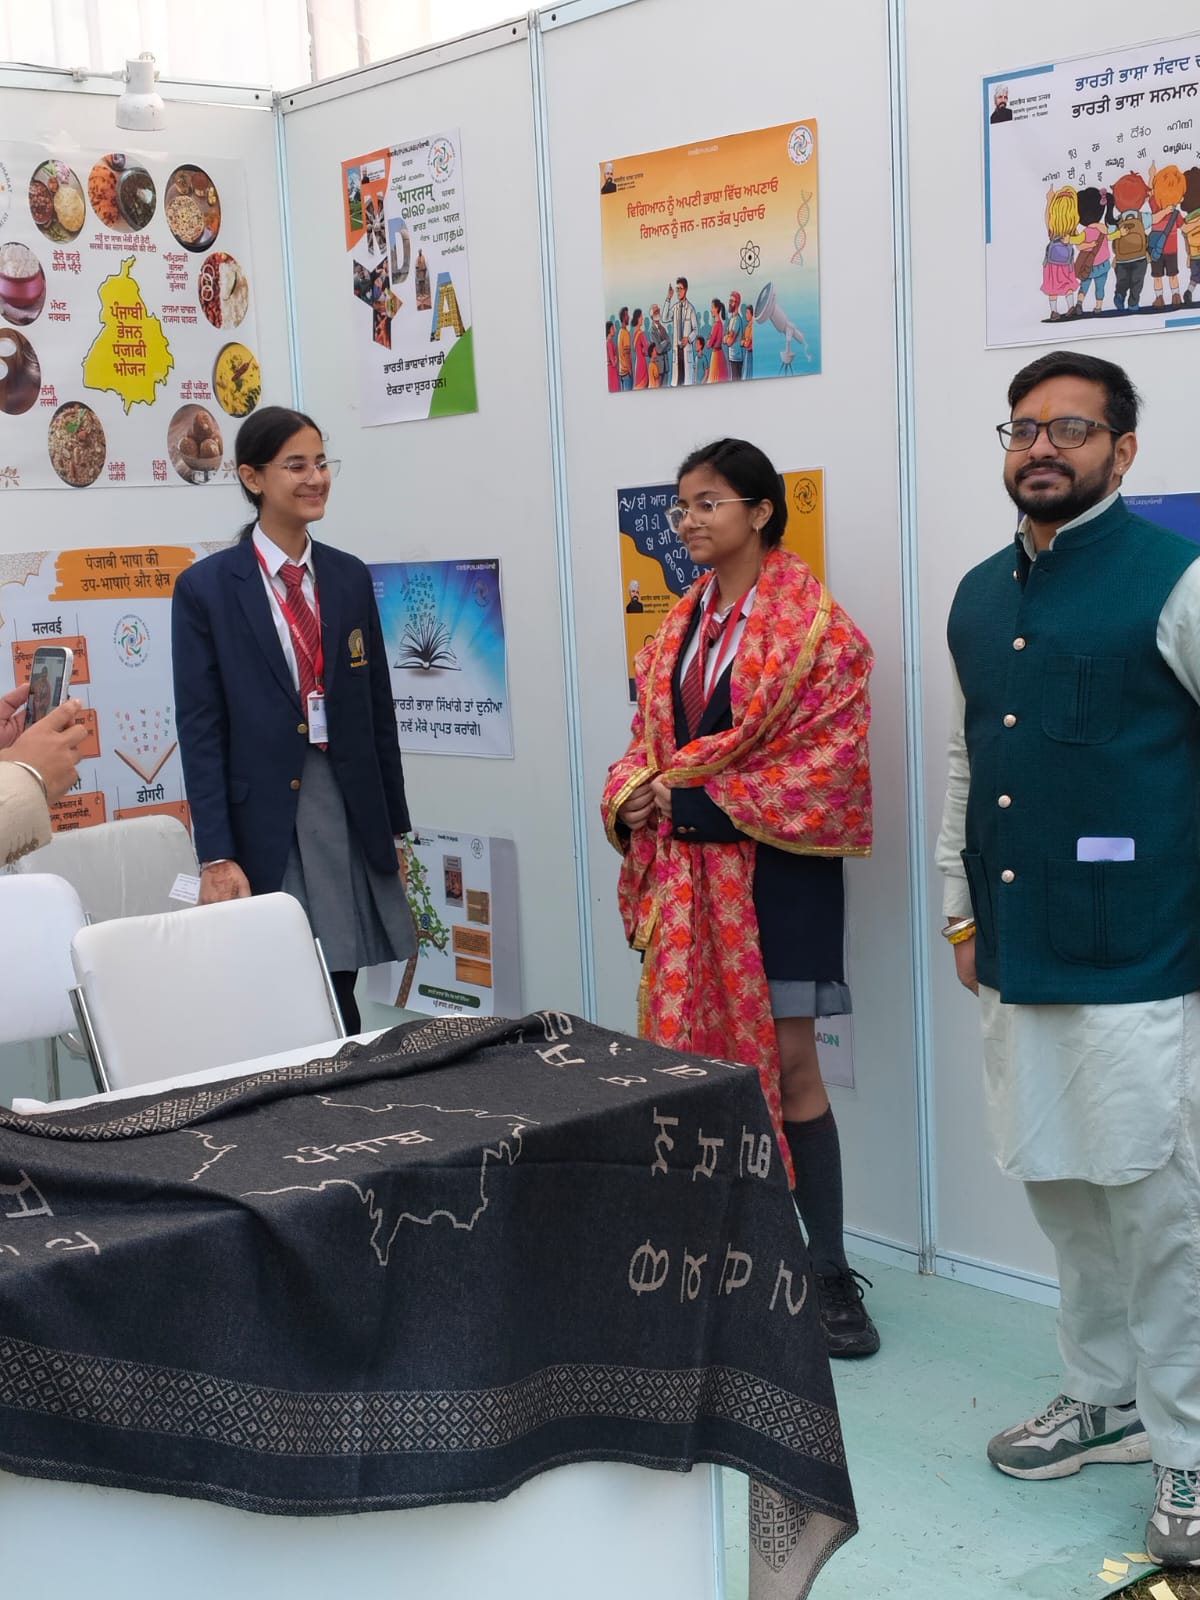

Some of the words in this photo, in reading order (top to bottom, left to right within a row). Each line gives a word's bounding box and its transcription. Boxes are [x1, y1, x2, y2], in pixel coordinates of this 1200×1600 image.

[1075, 68, 1114, 92] ਭਾਰਤੀ
[1119, 65, 1149, 84] ਭਾਸ਼ਾ
[1153, 56, 1190, 76] ਸੰਵਾਦ
[1072, 95, 1110, 119] ਭਾਰਤੀ
[1115, 93, 1145, 111] ਭਾਸ਼ਾ
[1150, 83, 1199, 104] ਸਨਮਾਨ
[397, 183, 436, 205] भारतम्
[627, 200, 666, 219] ਵਿਗਿਆਨ
[667, 196, 675, 216] ਨੂੰ
[676, 190, 702, 209] ਅਪਣੀ
[724, 184, 742, 201] ਵਿੱਚ
[744, 177, 779, 197] ਅਪਣਾਓ
[640, 223, 670, 240] ਗਿਆਨ
[671, 218, 679, 239] ਨੂੰ
[680, 220, 695, 233] ਜਨ
[701, 216, 716, 230] ਜਨ
[717, 210, 731, 226] ਤੱਕ
[110, 301, 143, 321] ਪੰਜਾਬੀ
[117, 320, 142, 339] ਭੋਜਨ
[112, 340, 146, 358] पंजाबी
[113, 358, 146, 377] भोजन
[384, 358, 404, 374] ਭਾਰਤੀ
[428, 351, 445, 366] ਸਾਡੀ
[405, 383, 413, 392] ਦਾ
[414, 380, 430, 396] ਸੂਤਰ
[85, 551, 117, 570] पंजाबी
[120, 552, 143, 569] भाषा
[145, 548, 160, 566] की
[81, 573, 132, 593] उप-भाषाएं
[134, 568, 152, 588] और
[154, 569, 172, 587] क्षेत्र
[32, 616, 62, 635] मलवई
[463, 698, 474, 713] ਤਾਂ
[137, 783, 165, 803] डोगरी
[282, 1129, 435, 1164] ਪੰਜਾਬ
